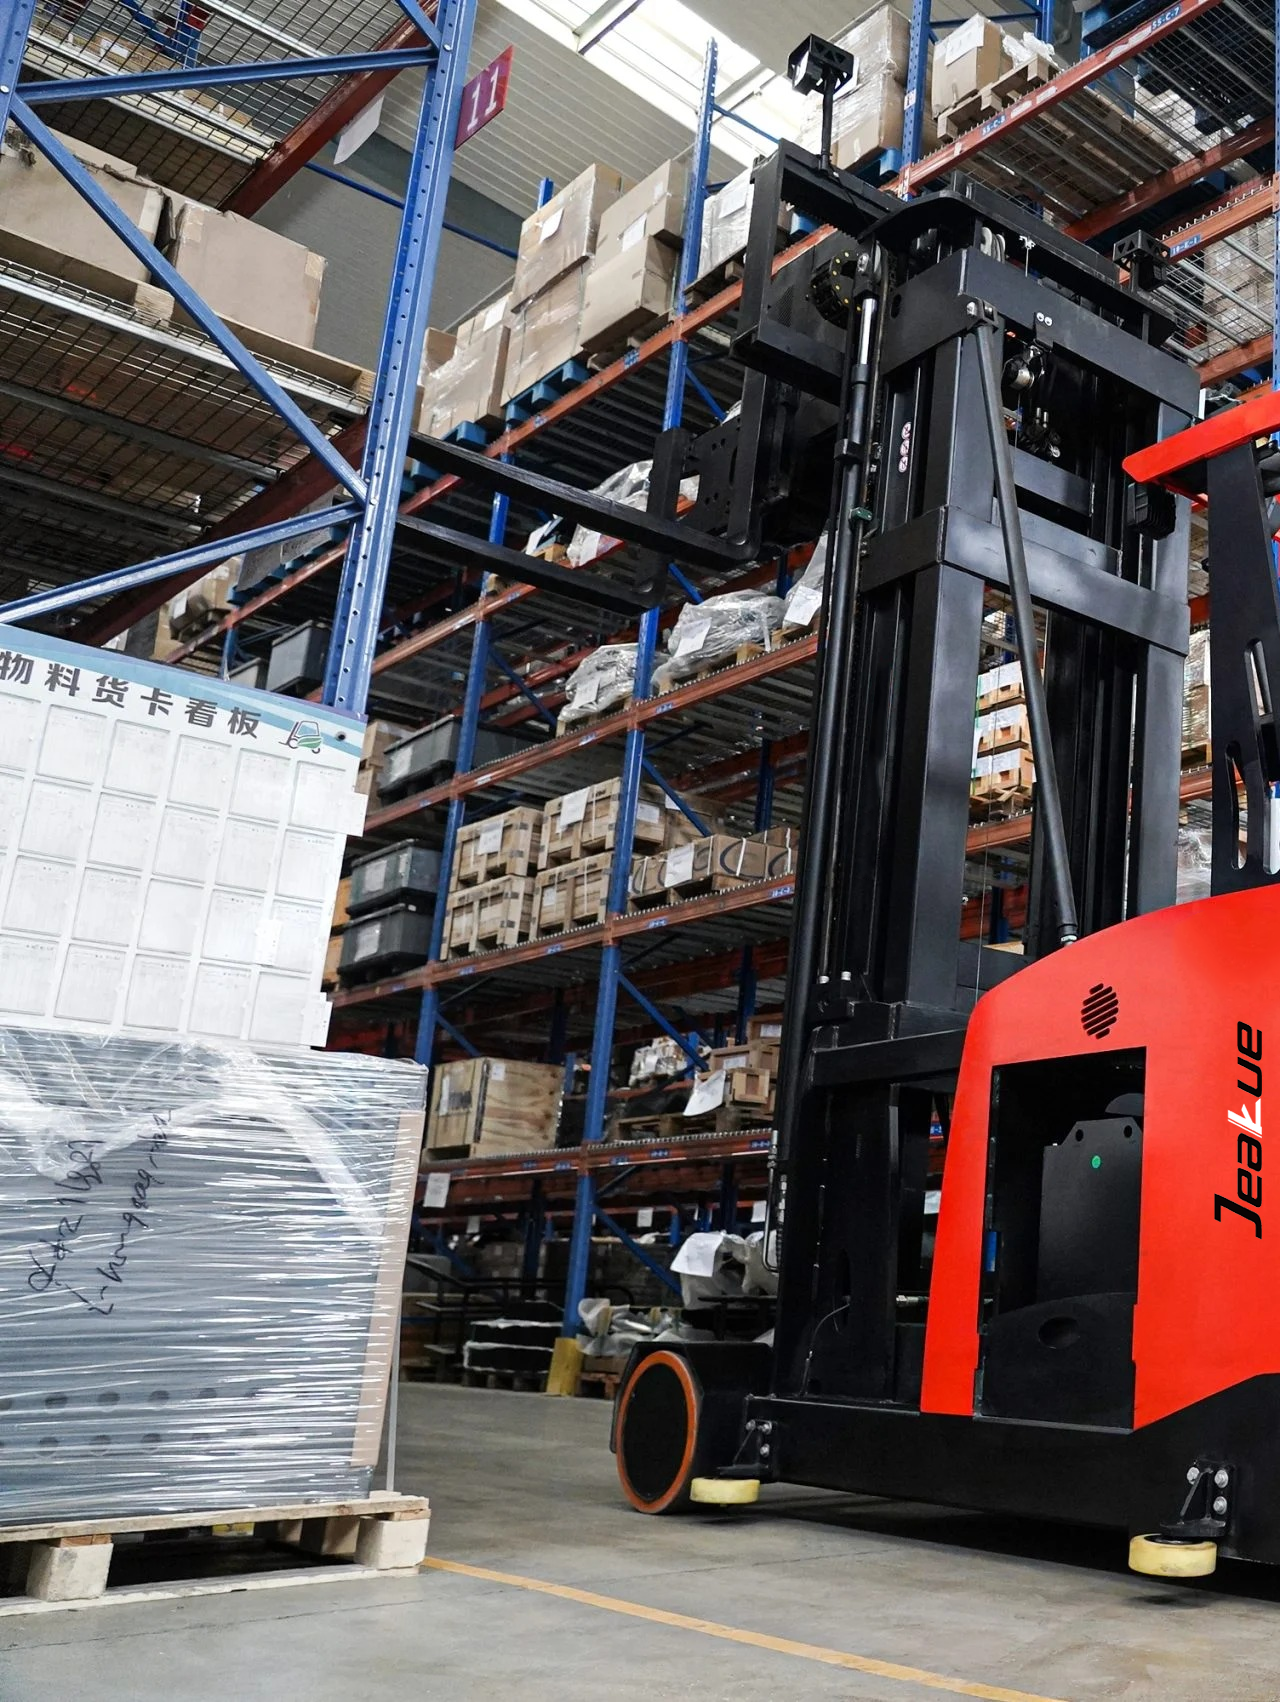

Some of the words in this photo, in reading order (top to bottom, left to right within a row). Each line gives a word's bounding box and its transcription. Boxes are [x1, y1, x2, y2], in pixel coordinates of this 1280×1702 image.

[466, 64, 500, 132] 11
[0, 651, 263, 740] 物料货卡看板
